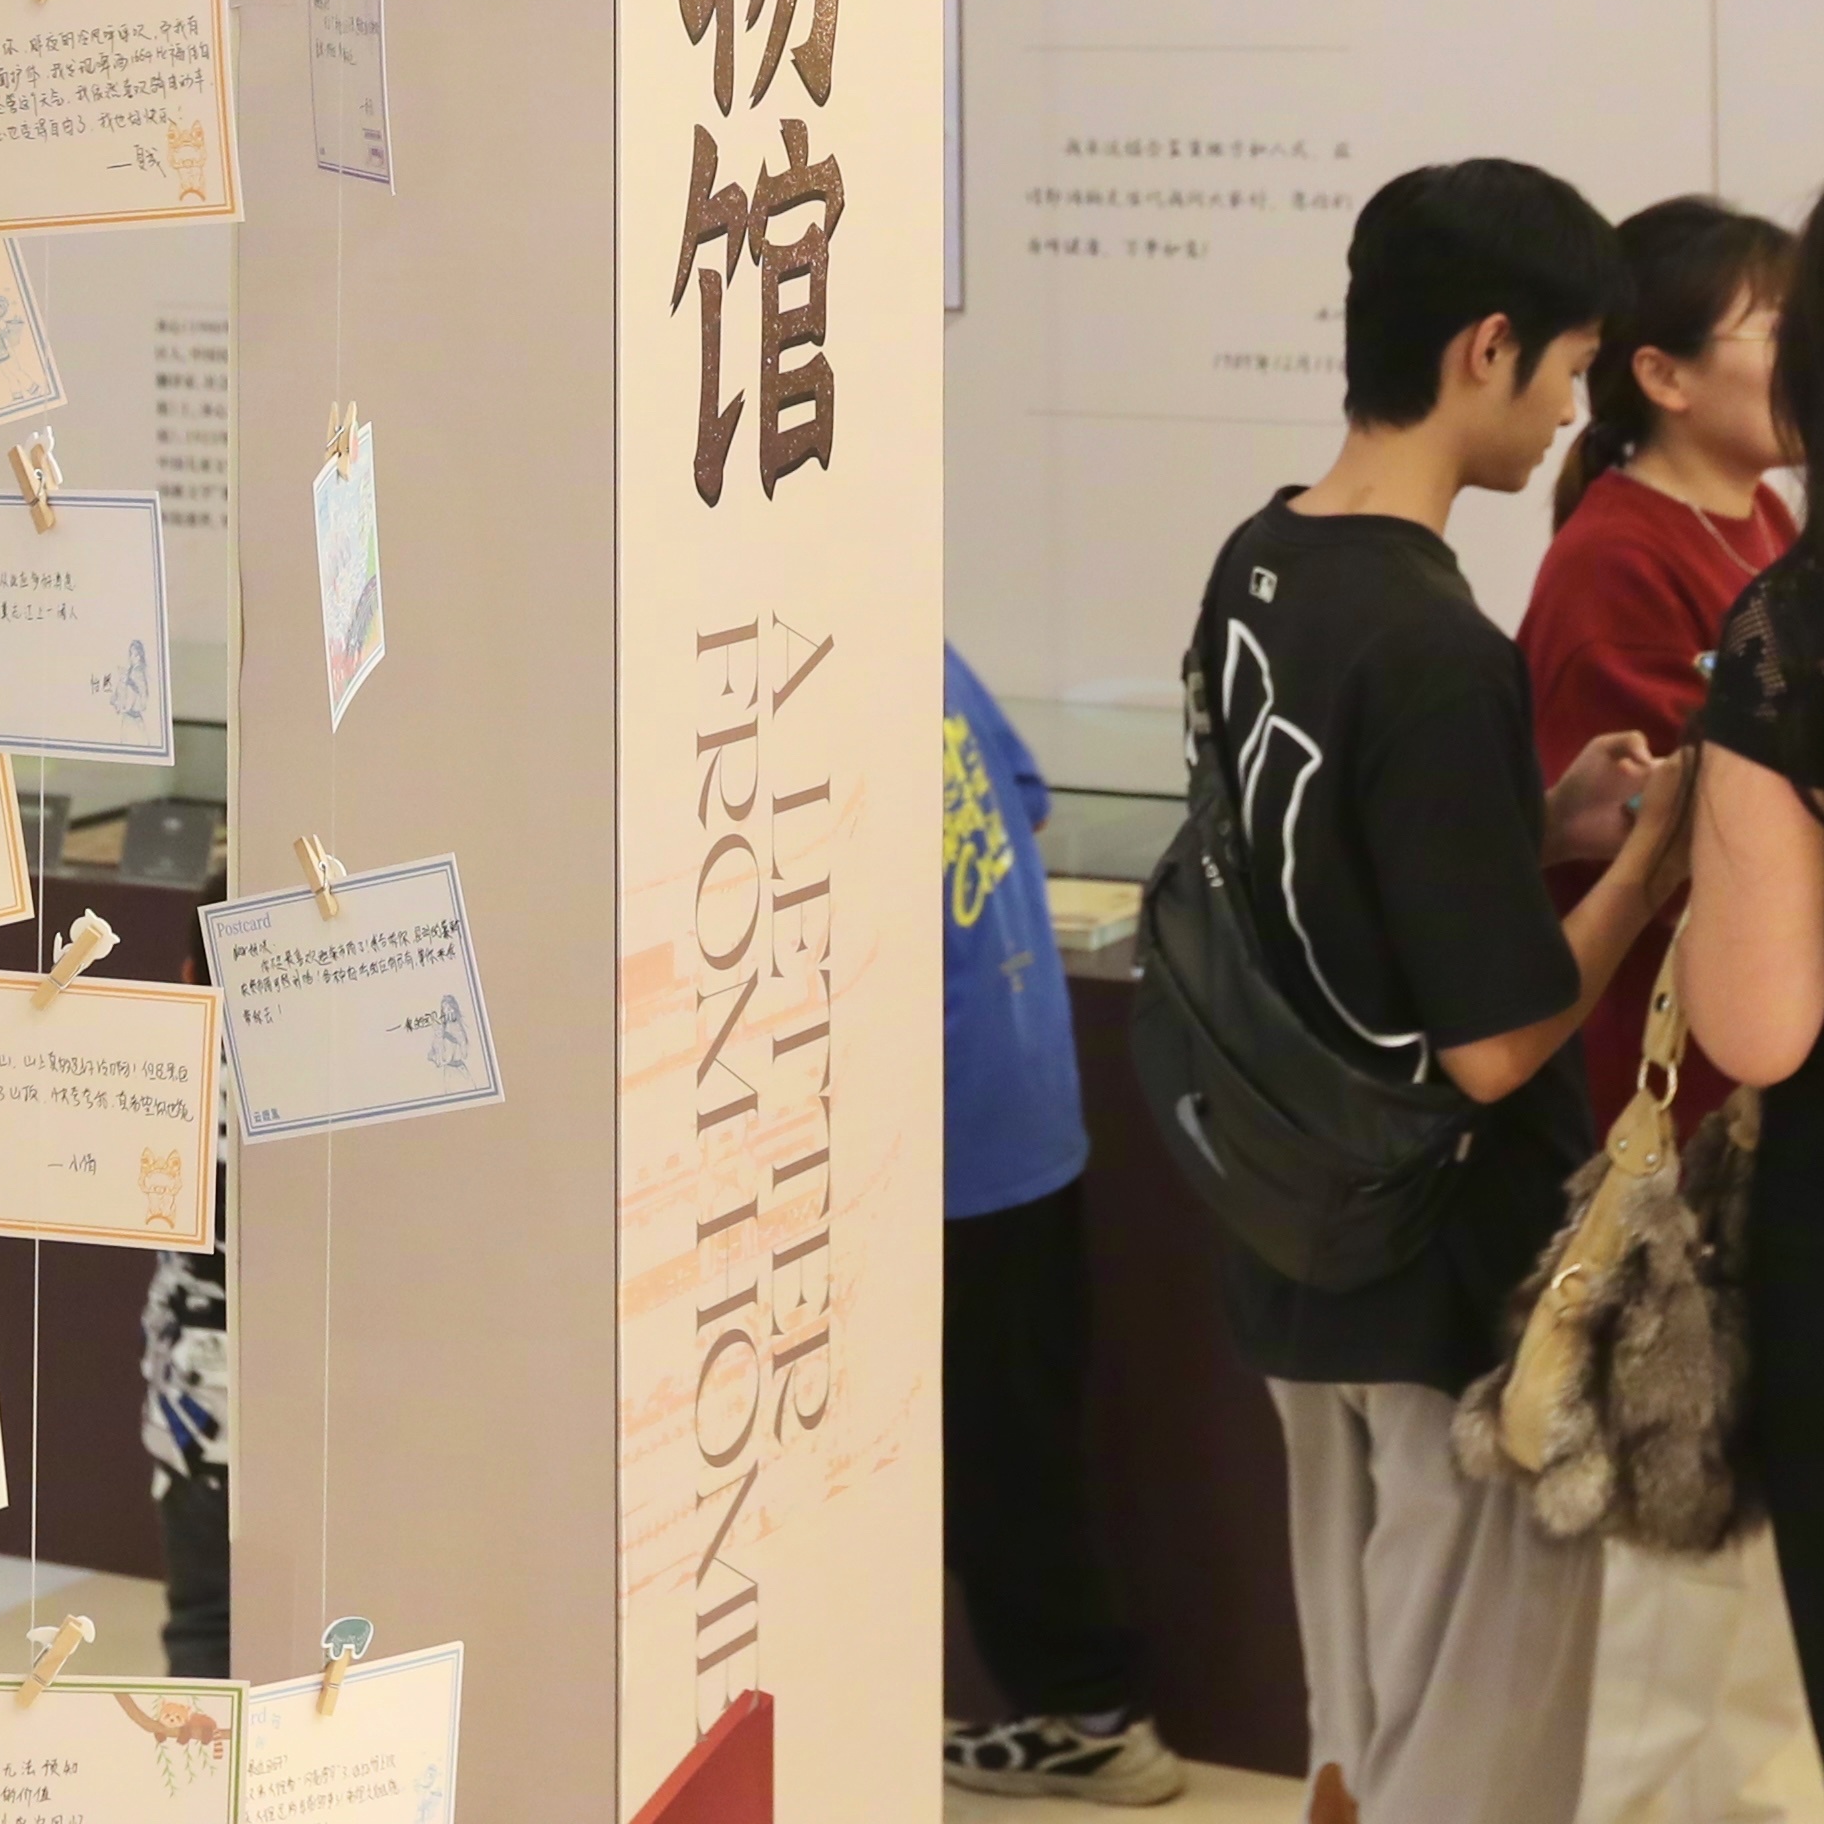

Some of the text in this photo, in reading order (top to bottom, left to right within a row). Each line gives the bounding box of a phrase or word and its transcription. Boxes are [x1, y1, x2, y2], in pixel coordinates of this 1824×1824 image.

[215, 912, 273, 939] Postcard
[696, 618, 760, 1744] FROM HOME
[773, 609, 835, 1439] A LETTER
